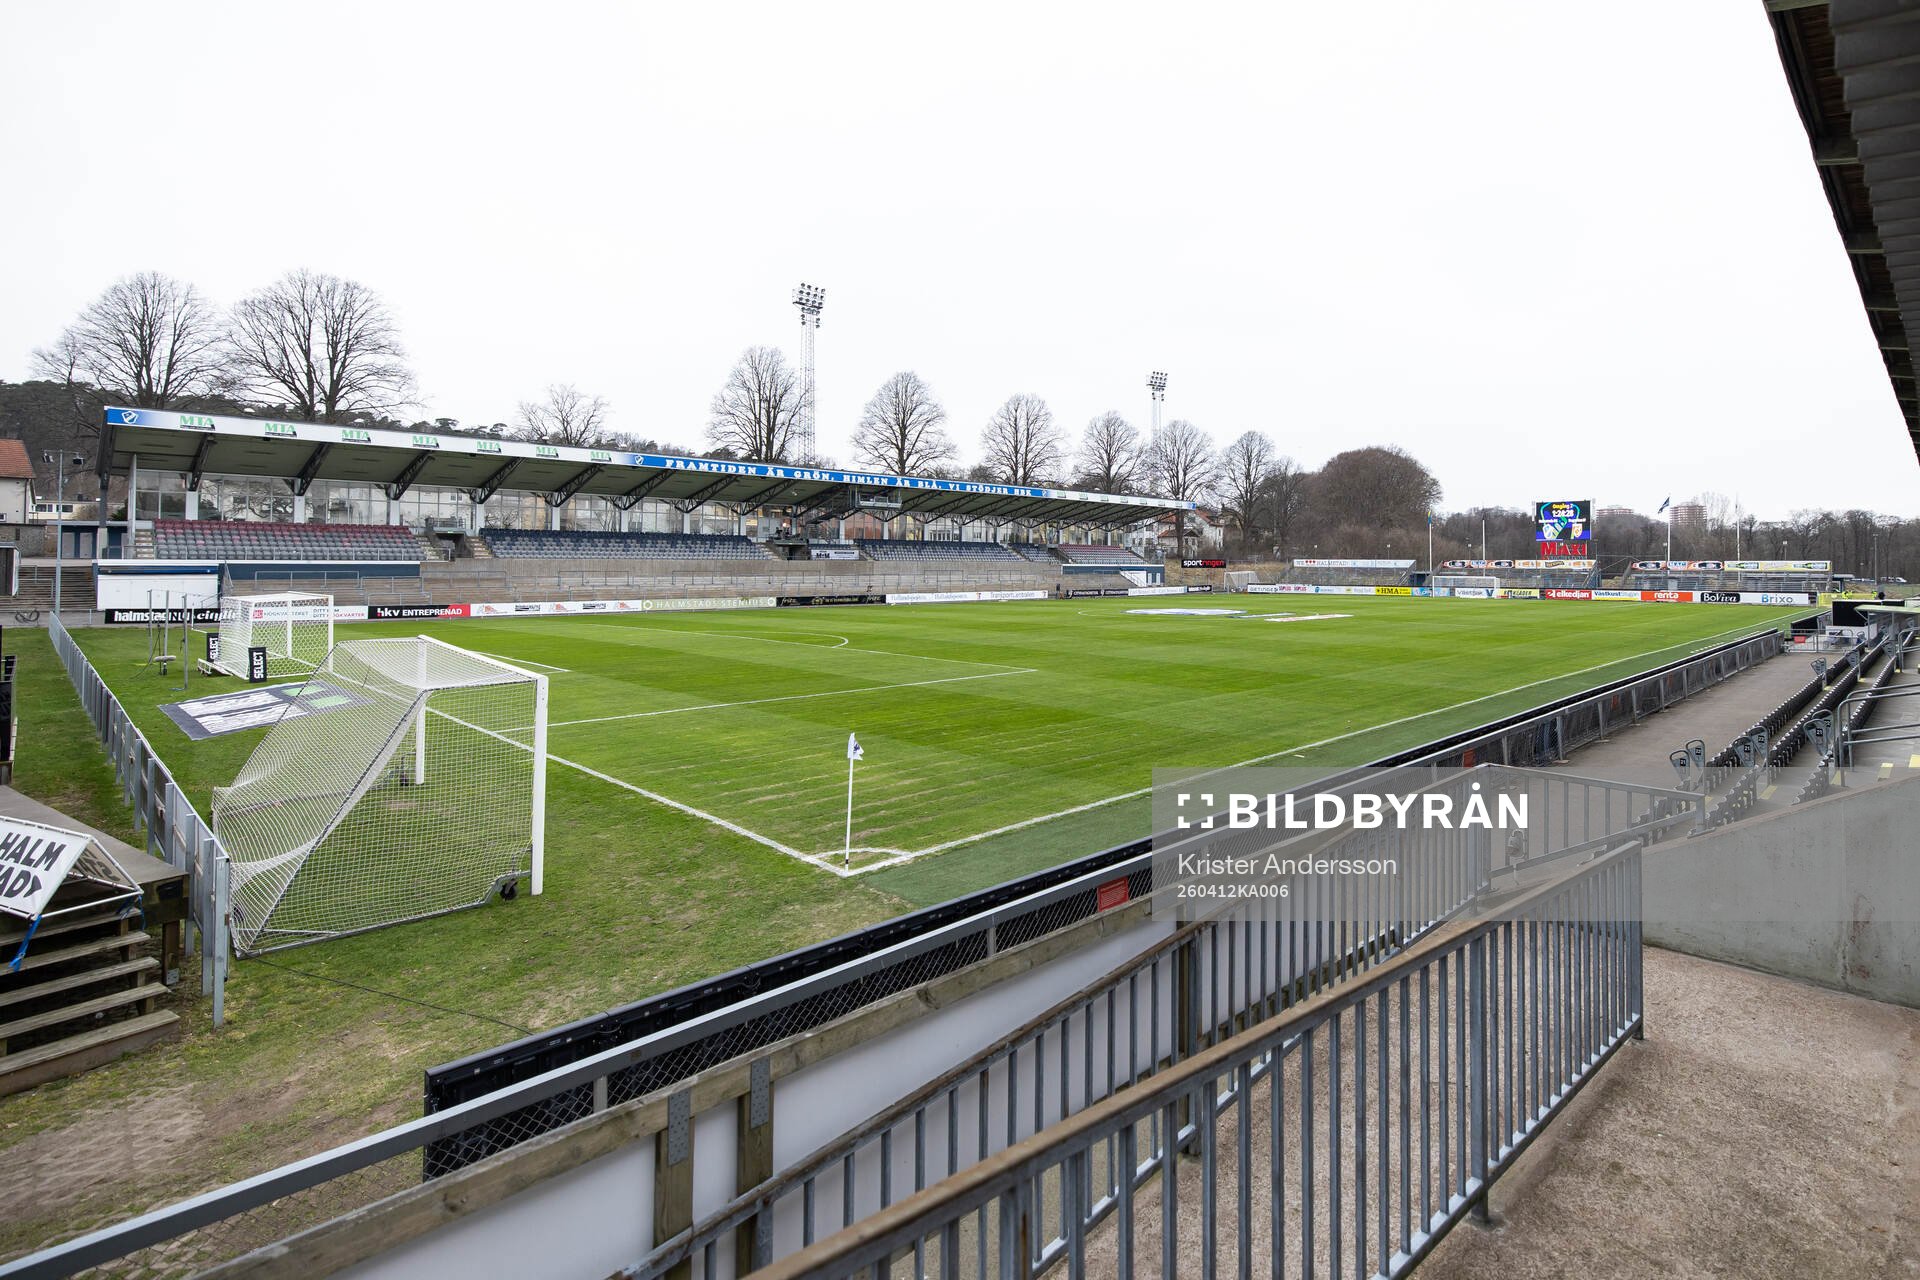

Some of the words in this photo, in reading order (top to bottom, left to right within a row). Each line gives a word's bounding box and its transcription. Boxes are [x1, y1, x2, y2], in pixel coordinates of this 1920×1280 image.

[180, 415, 215, 425] MTA
[265, 423, 297, 433] MTA
[342, 429, 369, 439] MTA
[412, 435, 438, 445] MTA
[476, 440, 501, 450] MTA
[536, 446, 558, 455] MTA
[590, 450, 612, 459] MTA
[665, 459, 757, 475] FRAMTIDEN
[766, 467, 784, 478] ÄR
[843, 474, 889, 486] HIMLEN
[896, 477, 911, 488] ÄR
[949, 483, 960, 491] VI
[966, 483, 1008, 495] STÖDJER
[1014, 488, 1031, 496] HBK
[1541, 542, 1587, 556] MAXI
[1183, 560, 1225, 568] sportringen
[1381, 587, 1399, 595] HMA
[1556, 589, 1590, 599] elkedjan
[1654, 591, 1679, 599] renta
[1703, 592, 1737, 602] BoViva
[1761, 593, 1794, 603] Brixo
[376, 607, 400, 617] hkv
[402, 608, 462, 616] ENTREPRENAD
[253, 651, 264, 679] SELECT
